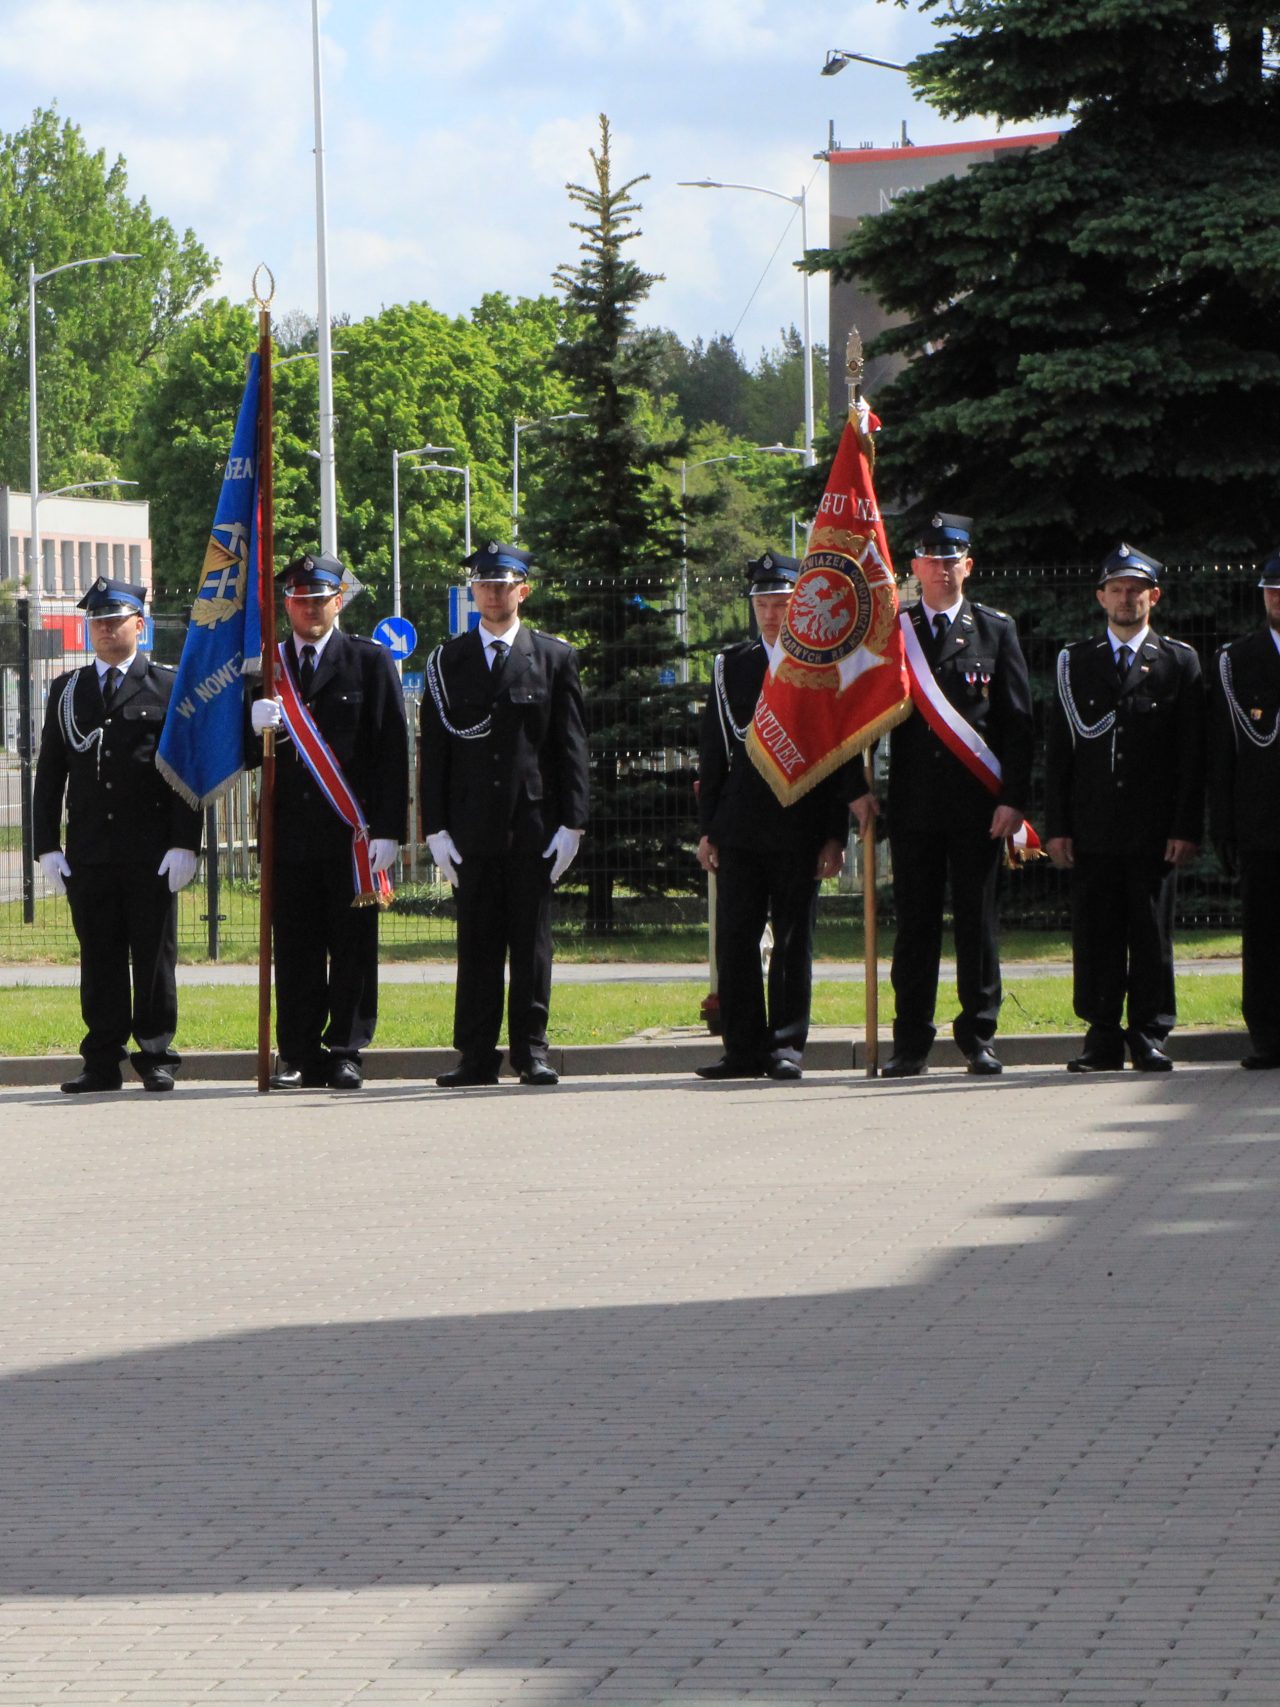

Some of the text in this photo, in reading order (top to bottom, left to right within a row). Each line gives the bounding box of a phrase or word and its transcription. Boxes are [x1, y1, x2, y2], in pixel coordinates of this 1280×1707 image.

[820, 492, 847, 515] GU
[176, 651, 241, 719] W NOWE
